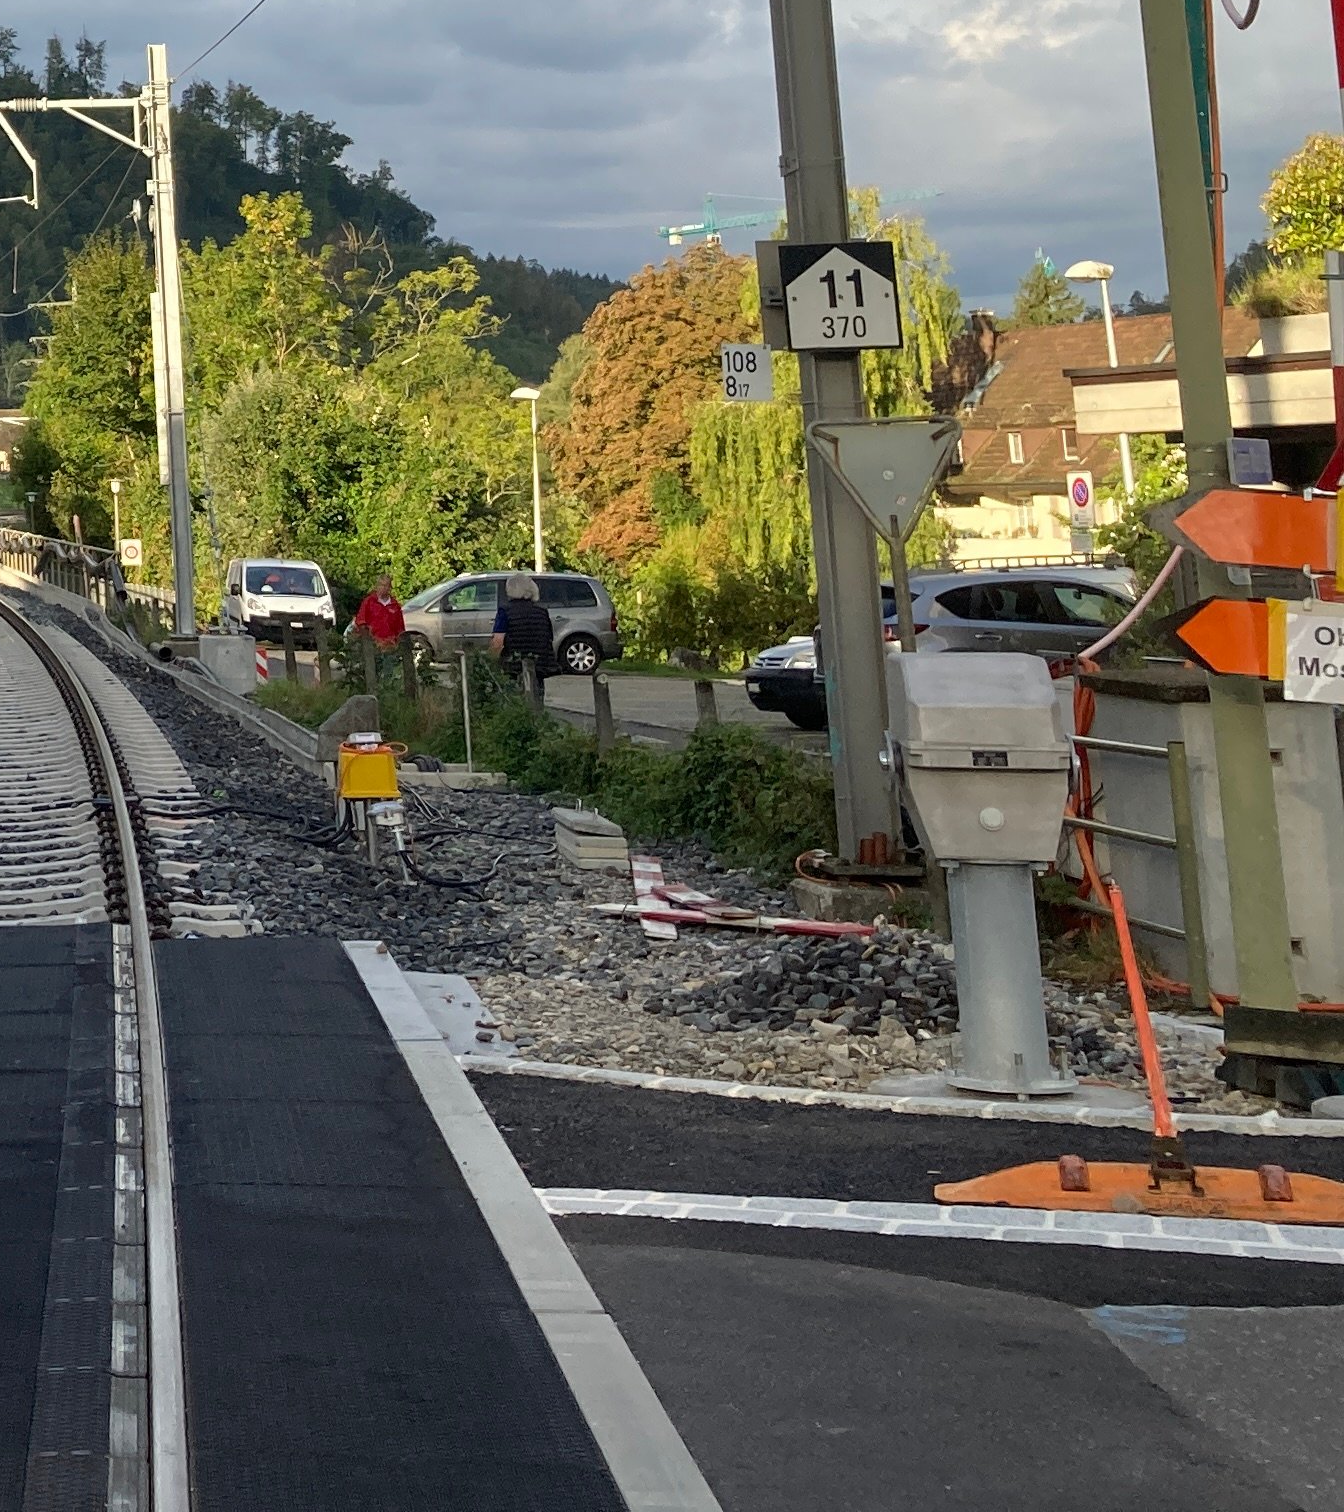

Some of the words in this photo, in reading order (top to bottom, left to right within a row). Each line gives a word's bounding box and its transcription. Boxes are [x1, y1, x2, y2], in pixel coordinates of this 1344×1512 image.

[819, 269, 864, 308] 11
[821, 315, 867, 339] 370
[724, 350, 758, 373] 108
[1298, 656, 1344, 678] Mo
